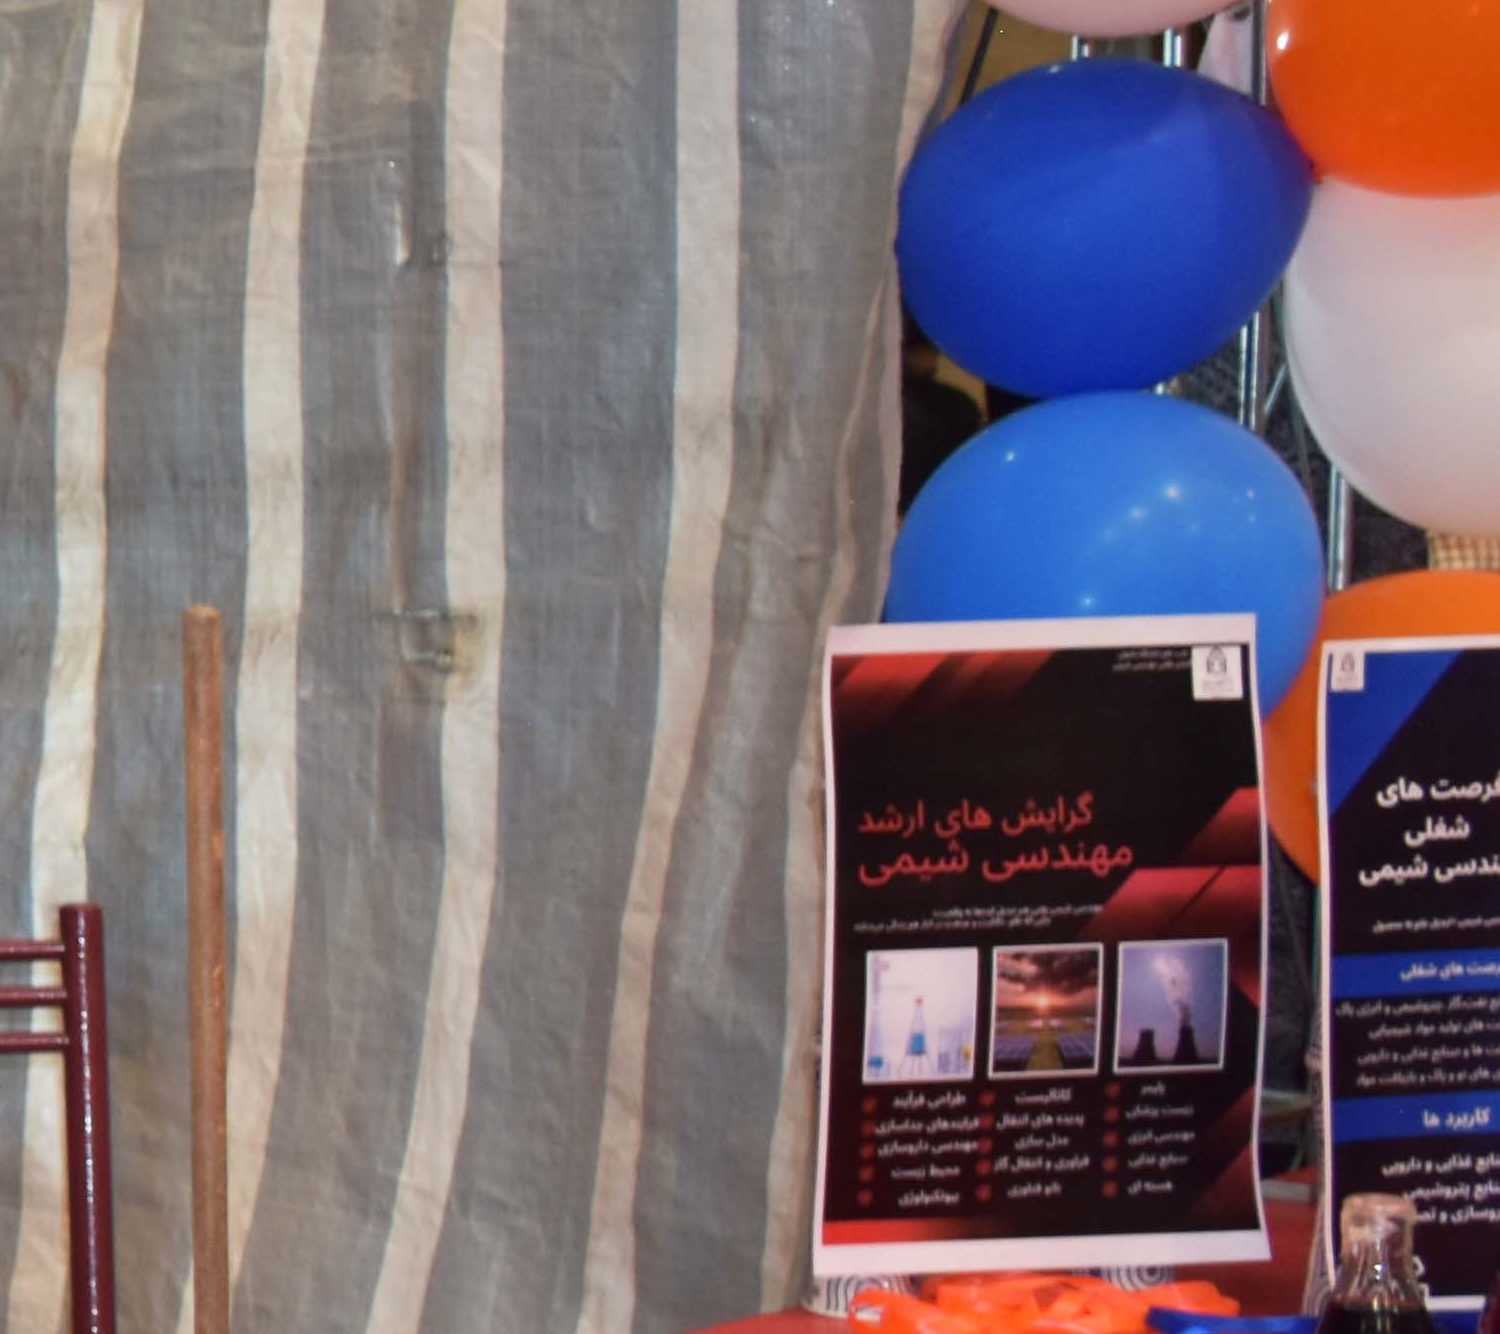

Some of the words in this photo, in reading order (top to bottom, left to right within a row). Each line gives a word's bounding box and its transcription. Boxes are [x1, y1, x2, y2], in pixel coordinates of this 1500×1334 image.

[1376, 776, 1424, 808] های
[859, 799, 925, 838] ارشد
[934, 798, 993, 838] های
[1001, 790, 1094, 837] گرایش
[1404, 814, 1471, 847] شغلی
[858, 838, 970, 887] شیمی
[982, 839, 1134, 882] مهندسی
[1358, 854, 1429, 888] شیمی
[1423, 1110, 1440, 1128] ها
[1446, 1107, 1491, 1129] کاربرد
